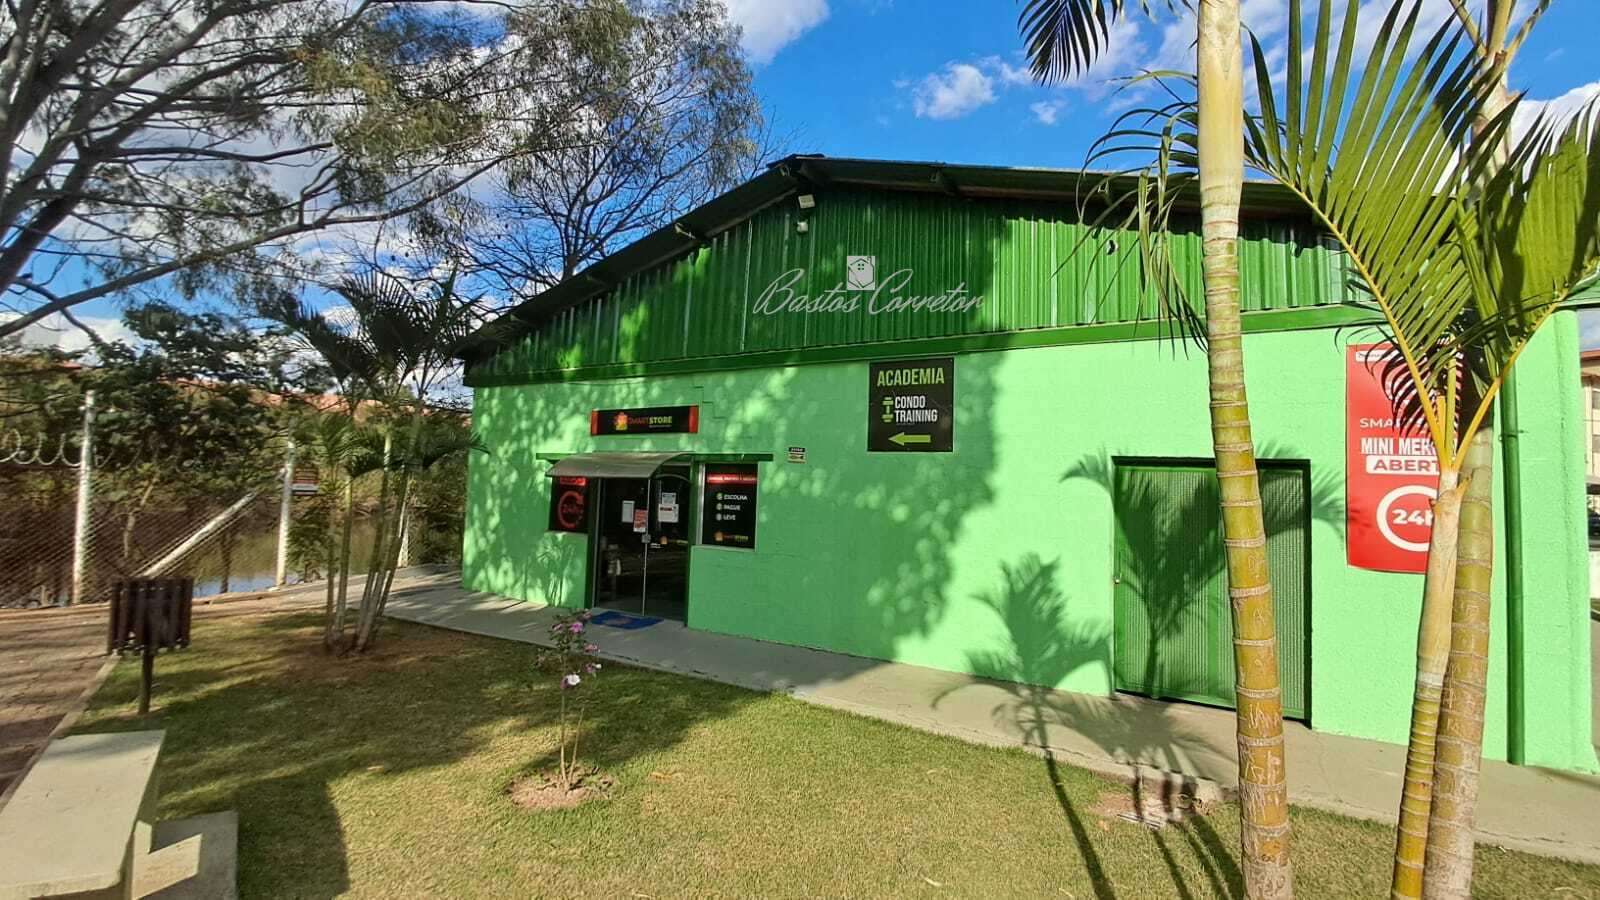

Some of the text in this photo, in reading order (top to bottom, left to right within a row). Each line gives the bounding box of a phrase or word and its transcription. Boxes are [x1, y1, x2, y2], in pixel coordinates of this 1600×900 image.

[877, 367, 945, 387] ACADEMIA
[894, 395, 926, 409] CONDO
[894, 409, 938, 423] TRAINING
[1361, 437, 1394, 454] MINI
